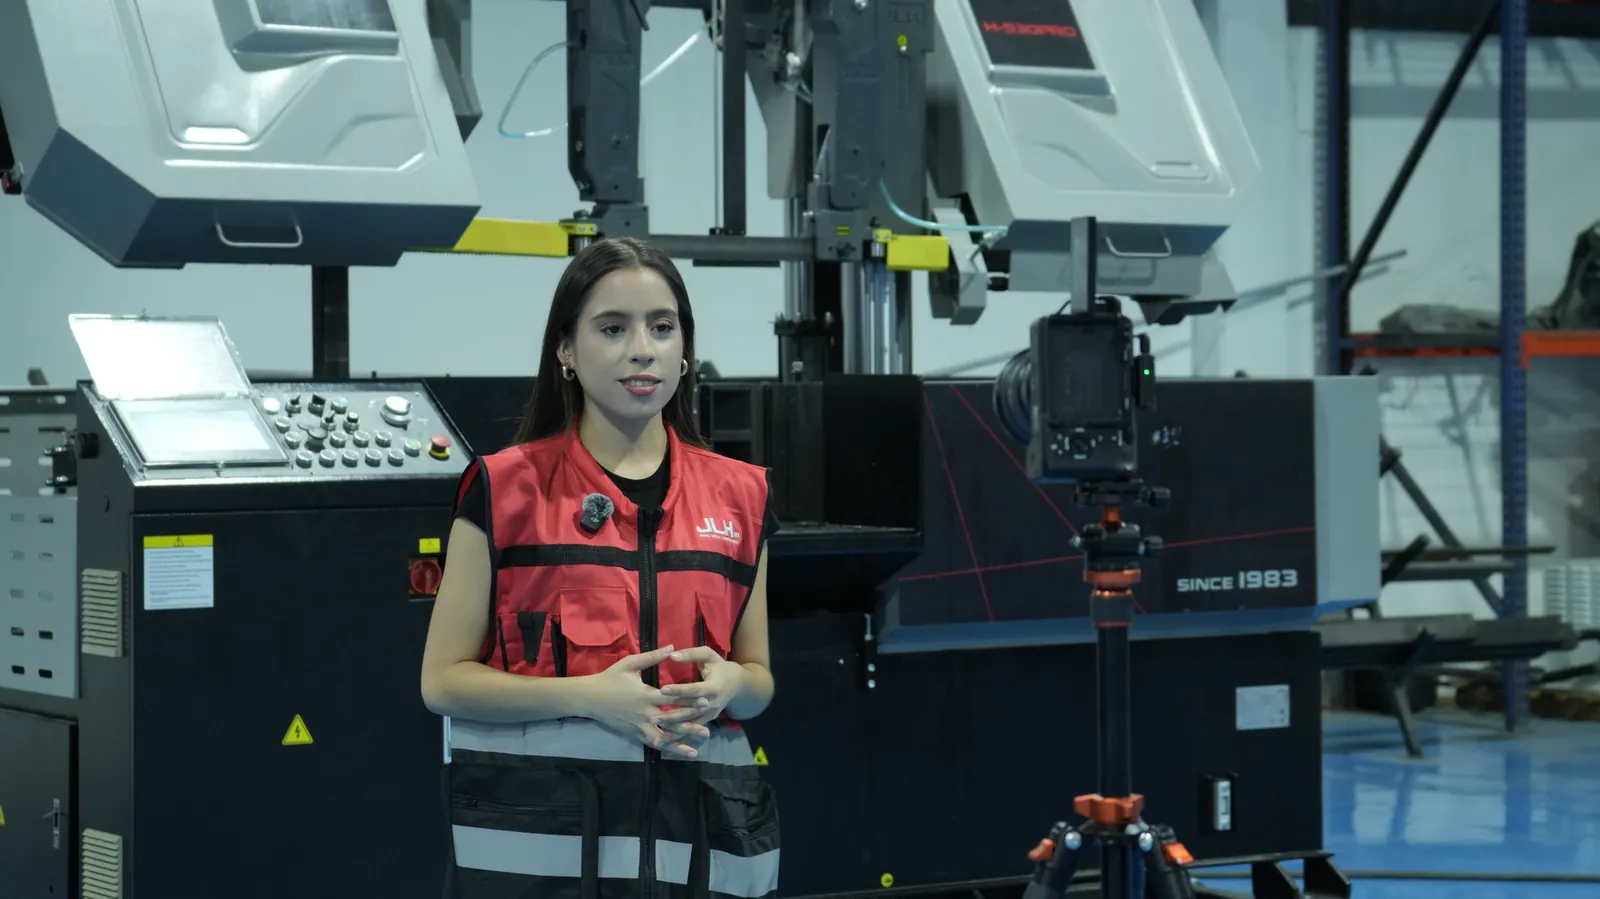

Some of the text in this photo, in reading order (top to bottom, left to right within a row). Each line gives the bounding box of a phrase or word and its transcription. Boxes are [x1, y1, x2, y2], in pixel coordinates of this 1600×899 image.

[696, 517, 734, 538] JLH
[1177, 569, 1298, 592] SINCE 1983
